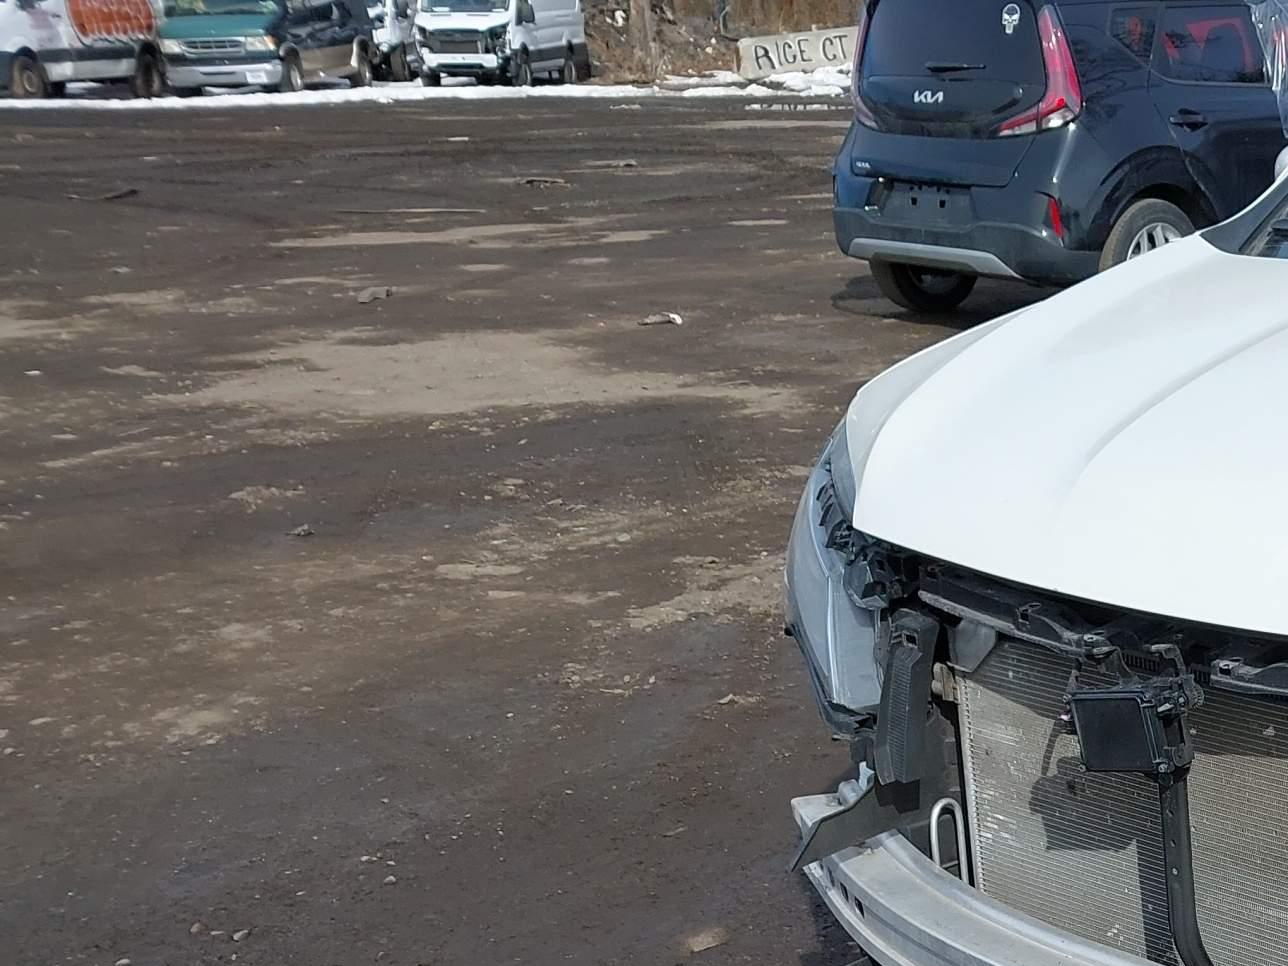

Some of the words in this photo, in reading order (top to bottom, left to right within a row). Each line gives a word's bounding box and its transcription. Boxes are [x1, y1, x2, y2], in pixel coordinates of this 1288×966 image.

[754, 39, 813, 70] RICE
[822, 35, 848, 61] CT
[913, 90, 944, 104] KIA
